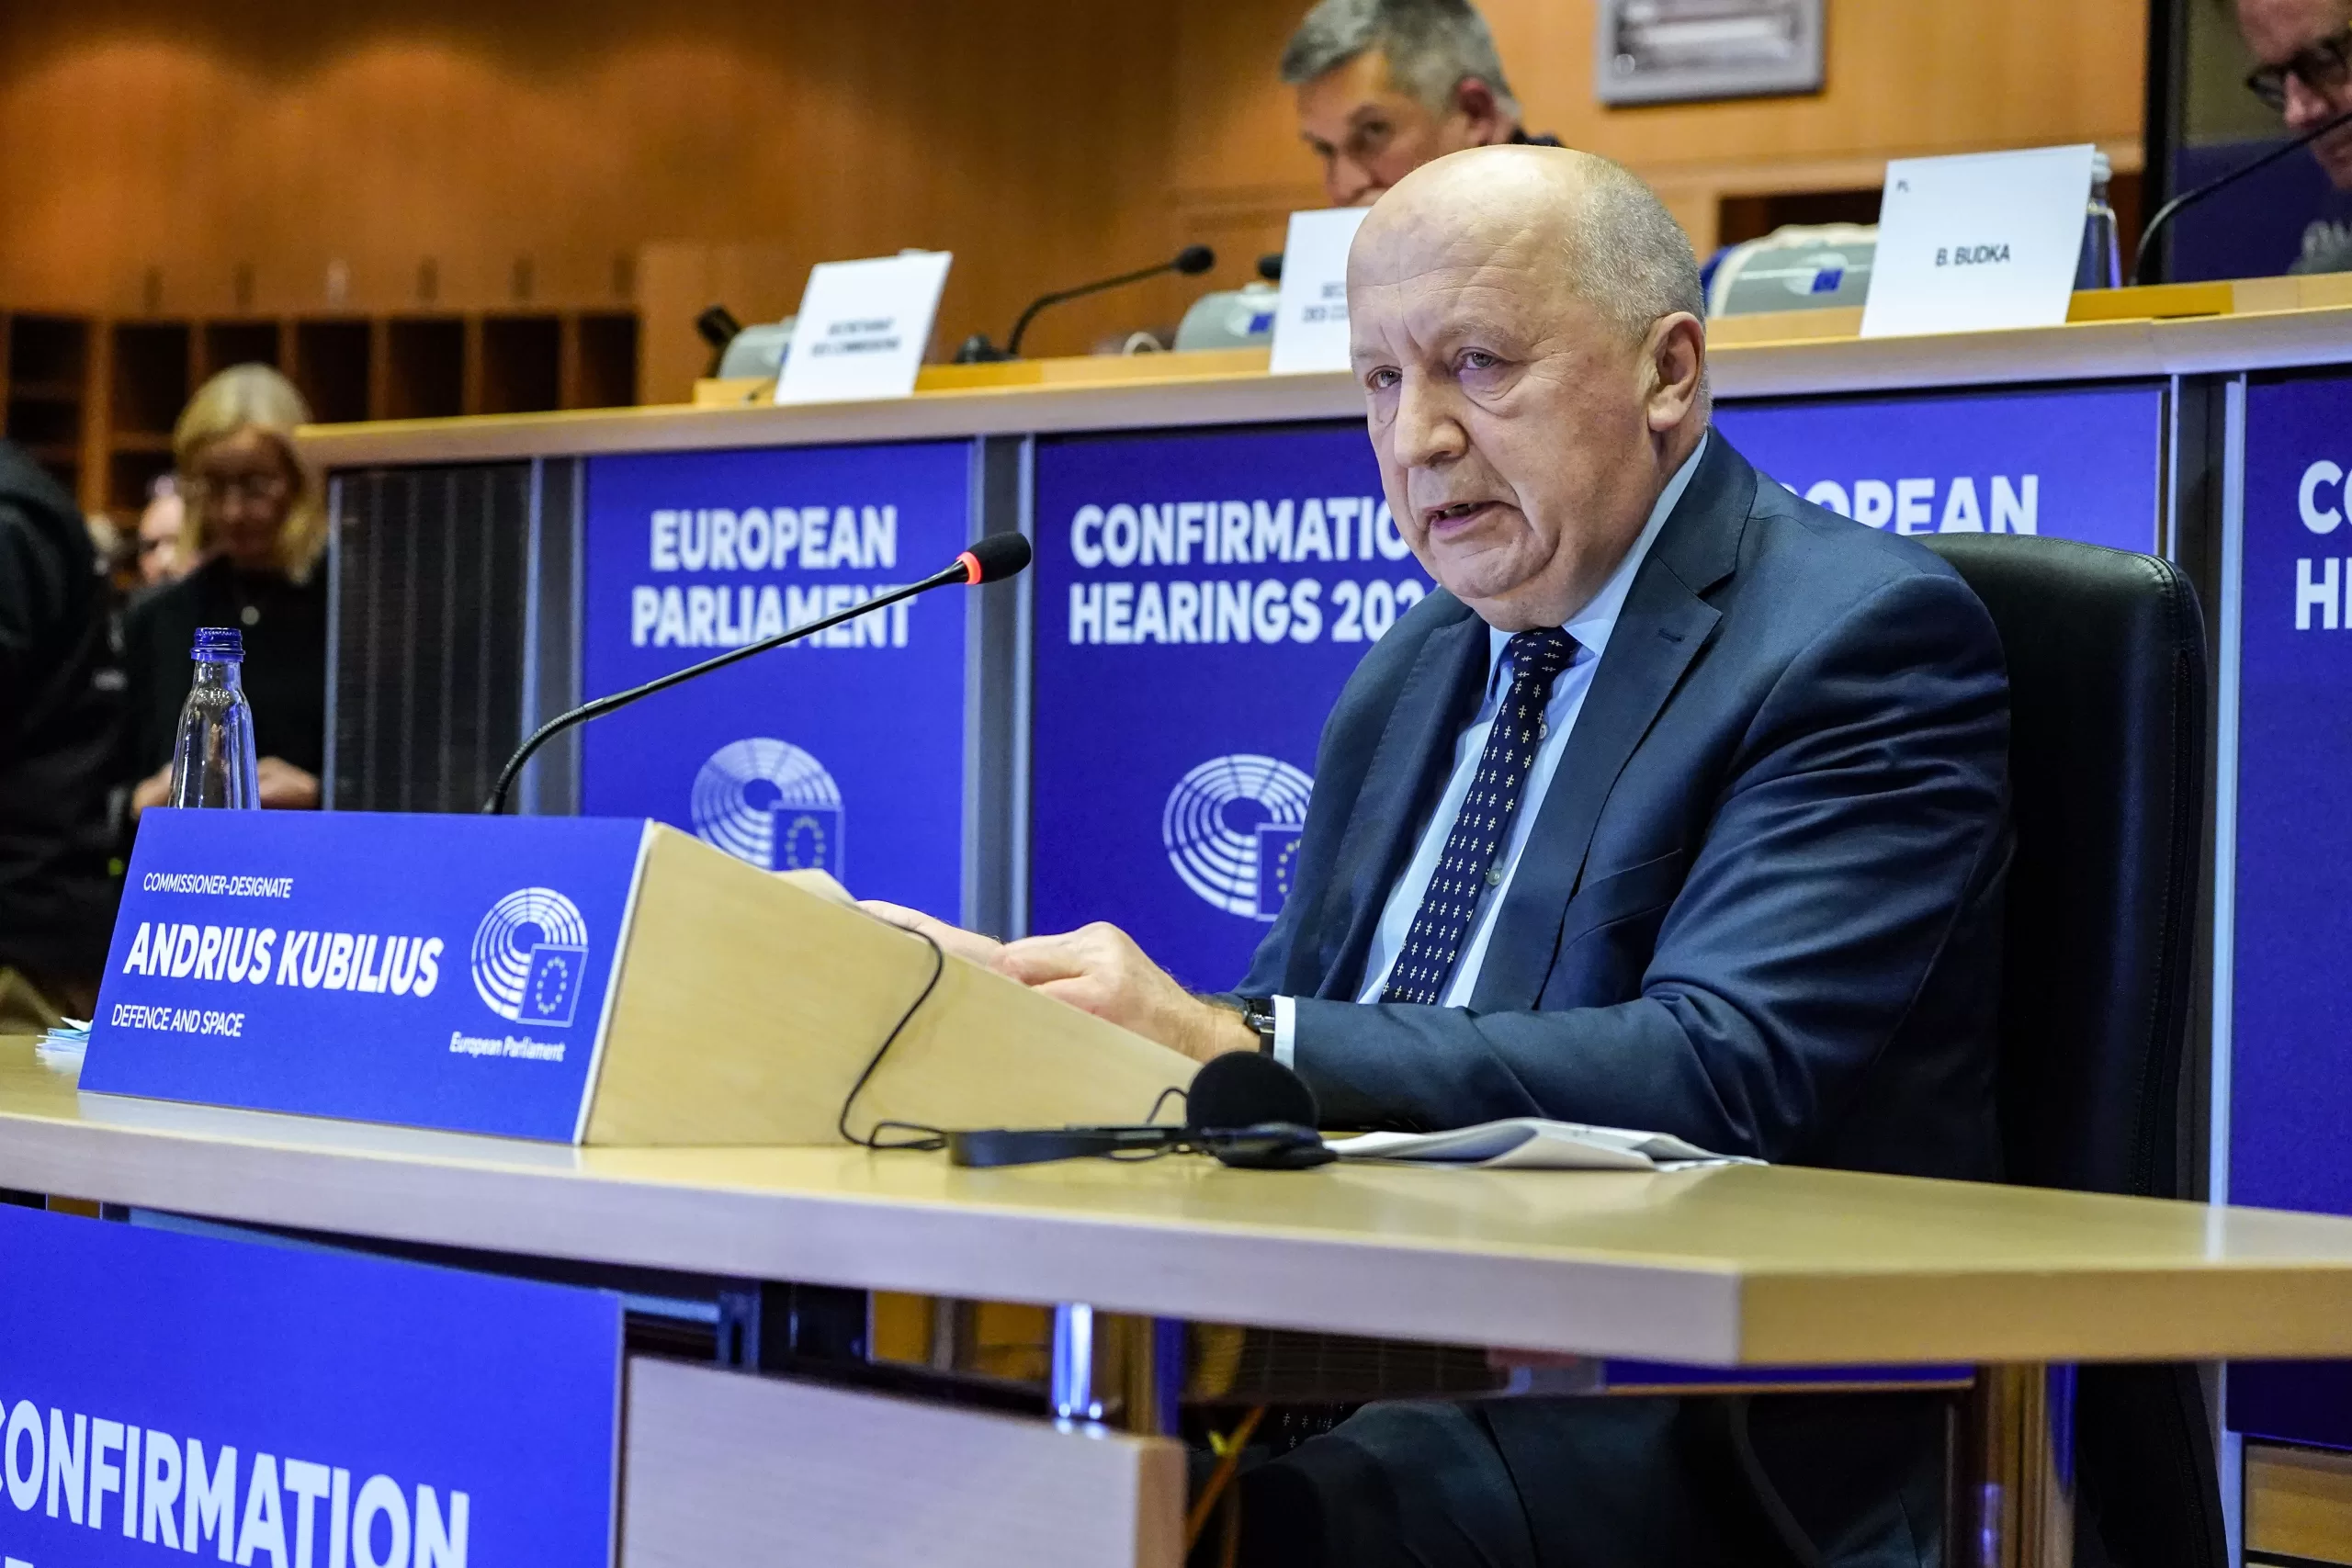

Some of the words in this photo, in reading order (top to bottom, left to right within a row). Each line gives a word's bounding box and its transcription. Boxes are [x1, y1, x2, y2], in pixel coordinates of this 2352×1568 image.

[1935, 247, 1950, 266] B.
[1954, 243, 2010, 265] BUDKA
[2299, 459, 2352, 535] C
[650, 505, 898, 571] EUROPEAN
[1070, 496, 1412, 569] CONFIRMATIO
[631, 585, 917, 649] PARLIAMENT
[1069, 578, 1323, 644] HEARINGS
[1330, 578, 1441, 643] 202
[2295, 557, 2352, 630] H
[143, 872, 294, 898] COMMISSIONER-DESIGNATE
[122, 921, 277, 986] ANDRIUS
[276, 930, 444, 998] KUBILIUS
[110, 1003, 173, 1031] DEFENCE
[170, 1009, 200, 1033] AND
[200, 1010, 245, 1038] SPACE
[449, 1031, 503, 1058] European
[0, 1398, 469, 1568] ONFIRMATION
